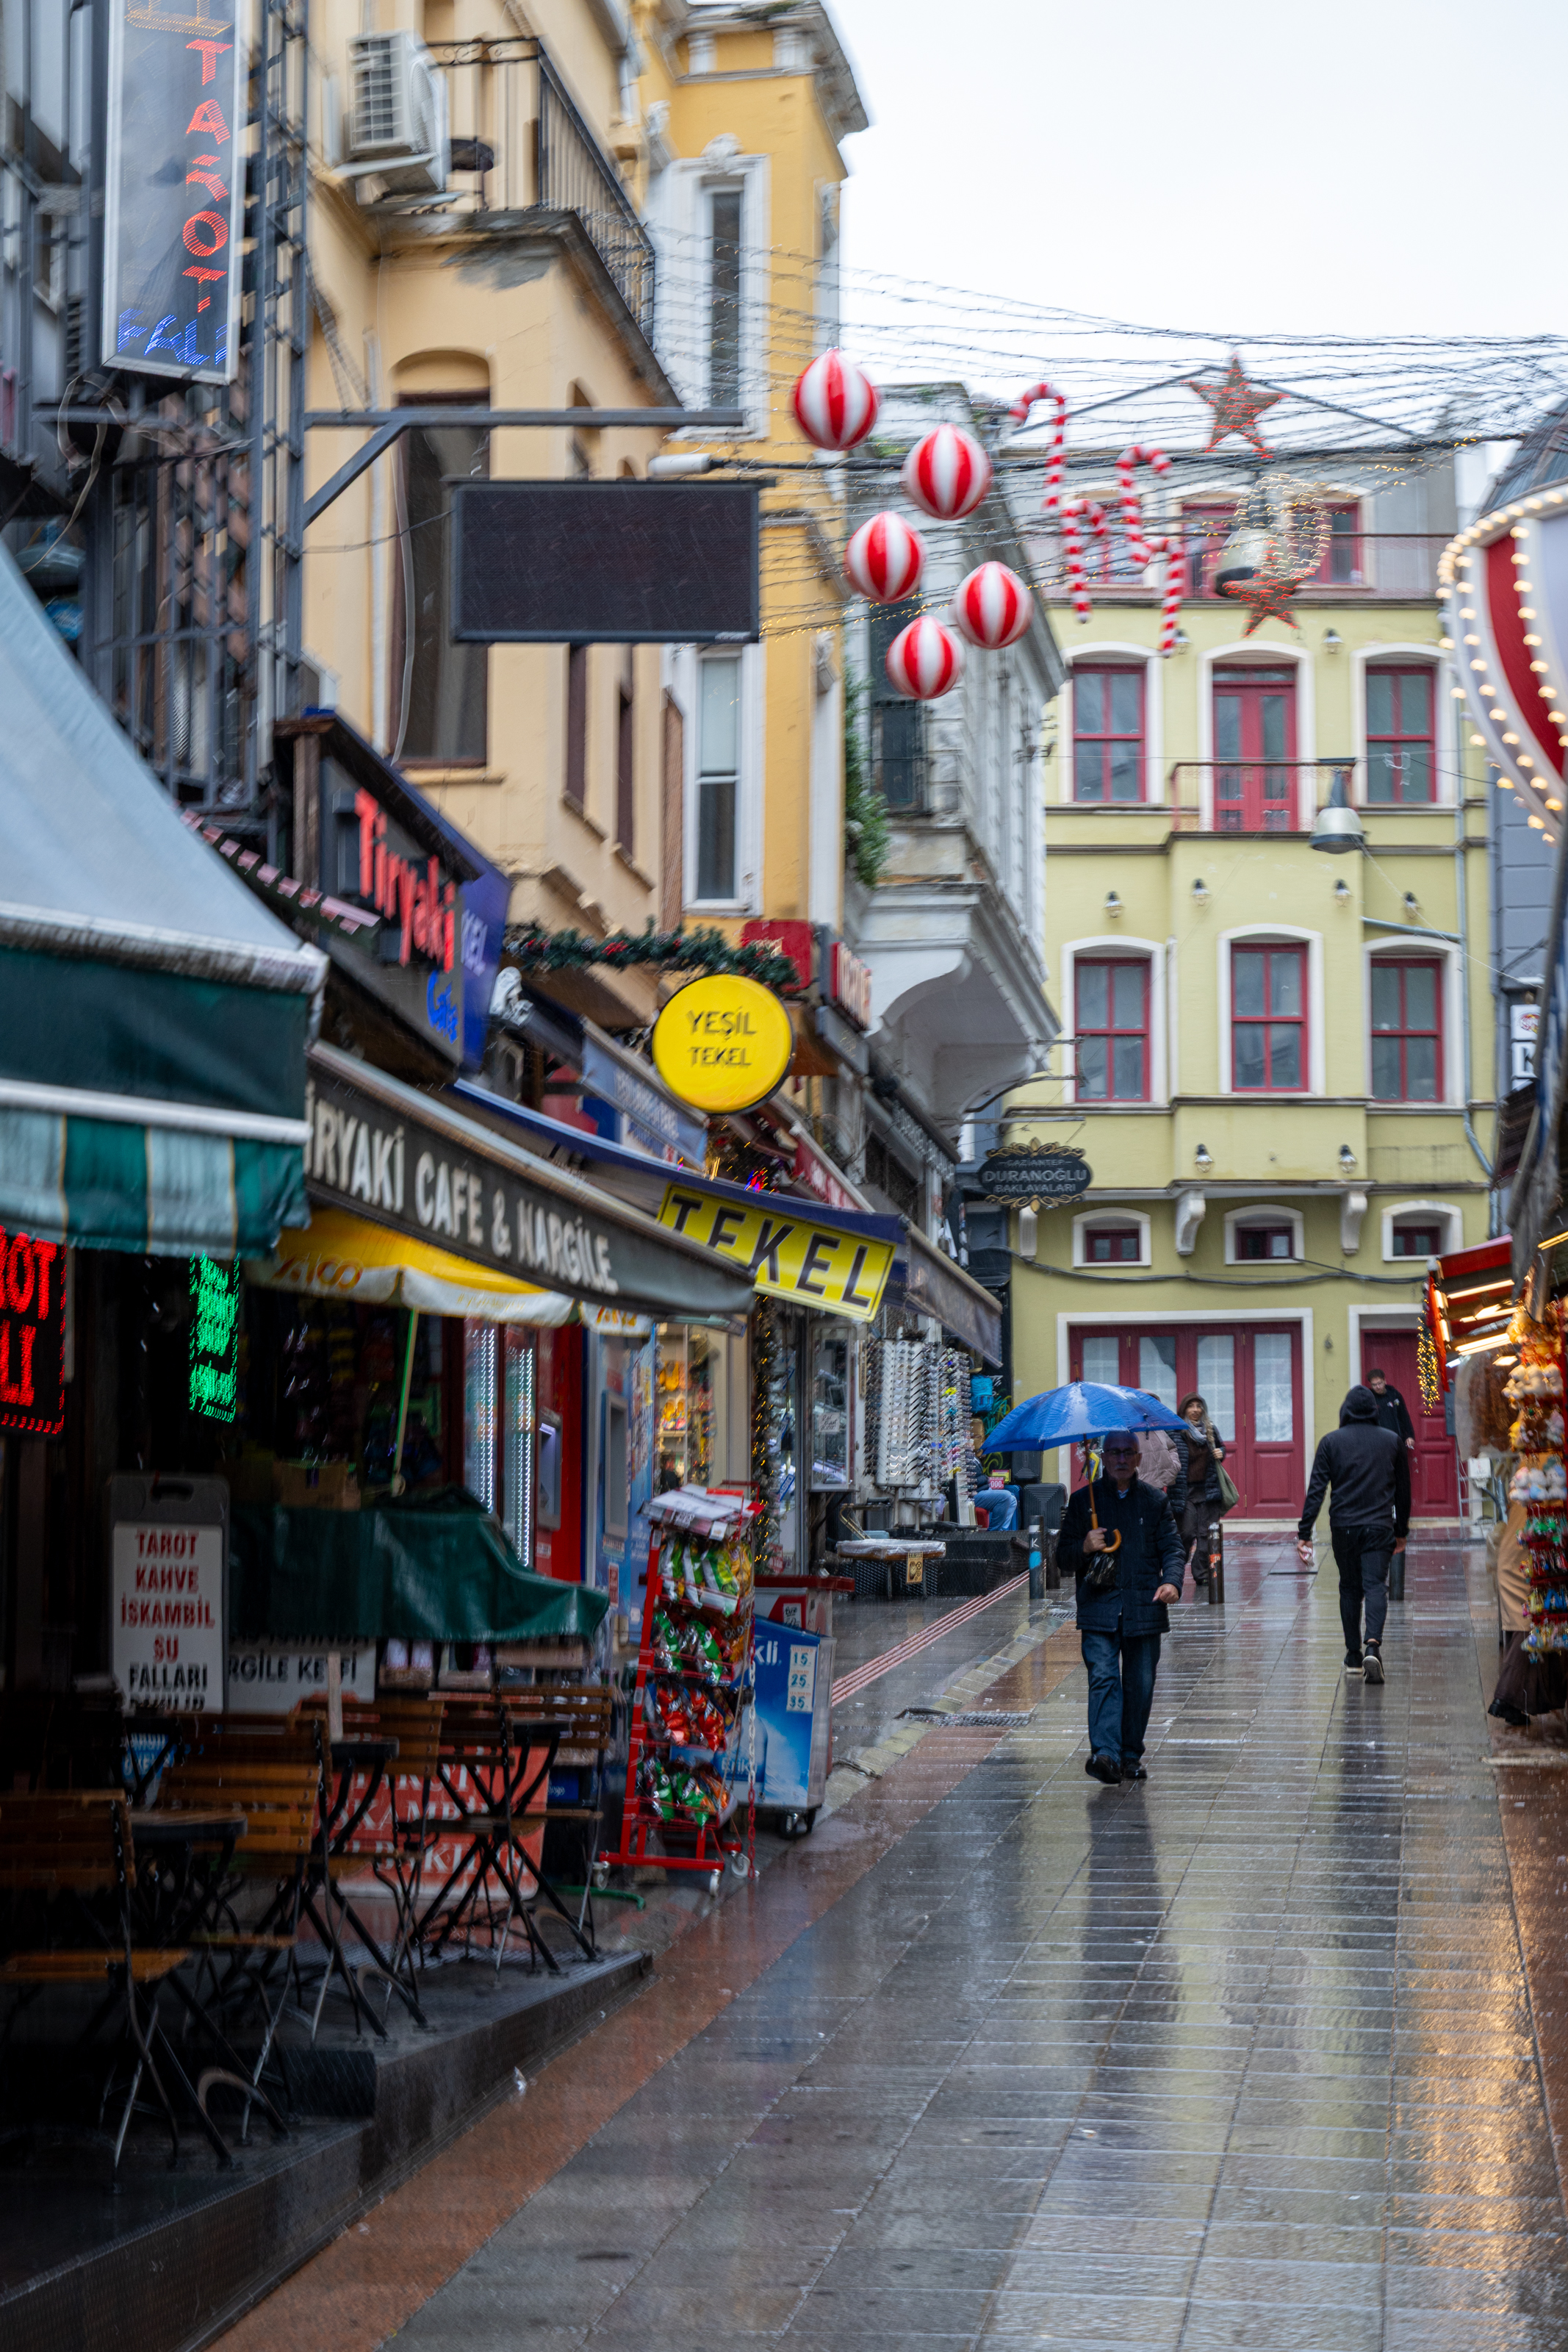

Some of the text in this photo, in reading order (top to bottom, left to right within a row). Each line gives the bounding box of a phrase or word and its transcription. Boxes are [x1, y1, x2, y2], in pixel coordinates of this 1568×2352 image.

[182, 38, 234, 314] TAROT
[355, 787, 456, 974] Tiryaki
[686, 1006, 758, 1042] YEŞİL
[688, 1047, 752, 1068] TEKEL
[303, 1079, 619, 1295] İRYAKİ CAFE & NARGİLE
[982, 1168, 1087, 1183] DURANOĞLU
[994, 1184, 1076, 1193] BAKLAVALARI
[670, 1194, 872, 1308] TEKEL
[135, 1529, 200, 1560] TAROT
[135, 1564, 200, 1595] KAHVE
[121, 1594, 215, 1629] İSKAMBİL
[153, 1634, 179, 1664] SU
[794, 1652, 808, 1666] 15
[129, 1662, 208, 1692] FALLARI
[298, 1649, 356, 1685] KEFİ
[791, 1674, 807, 1688] 25
